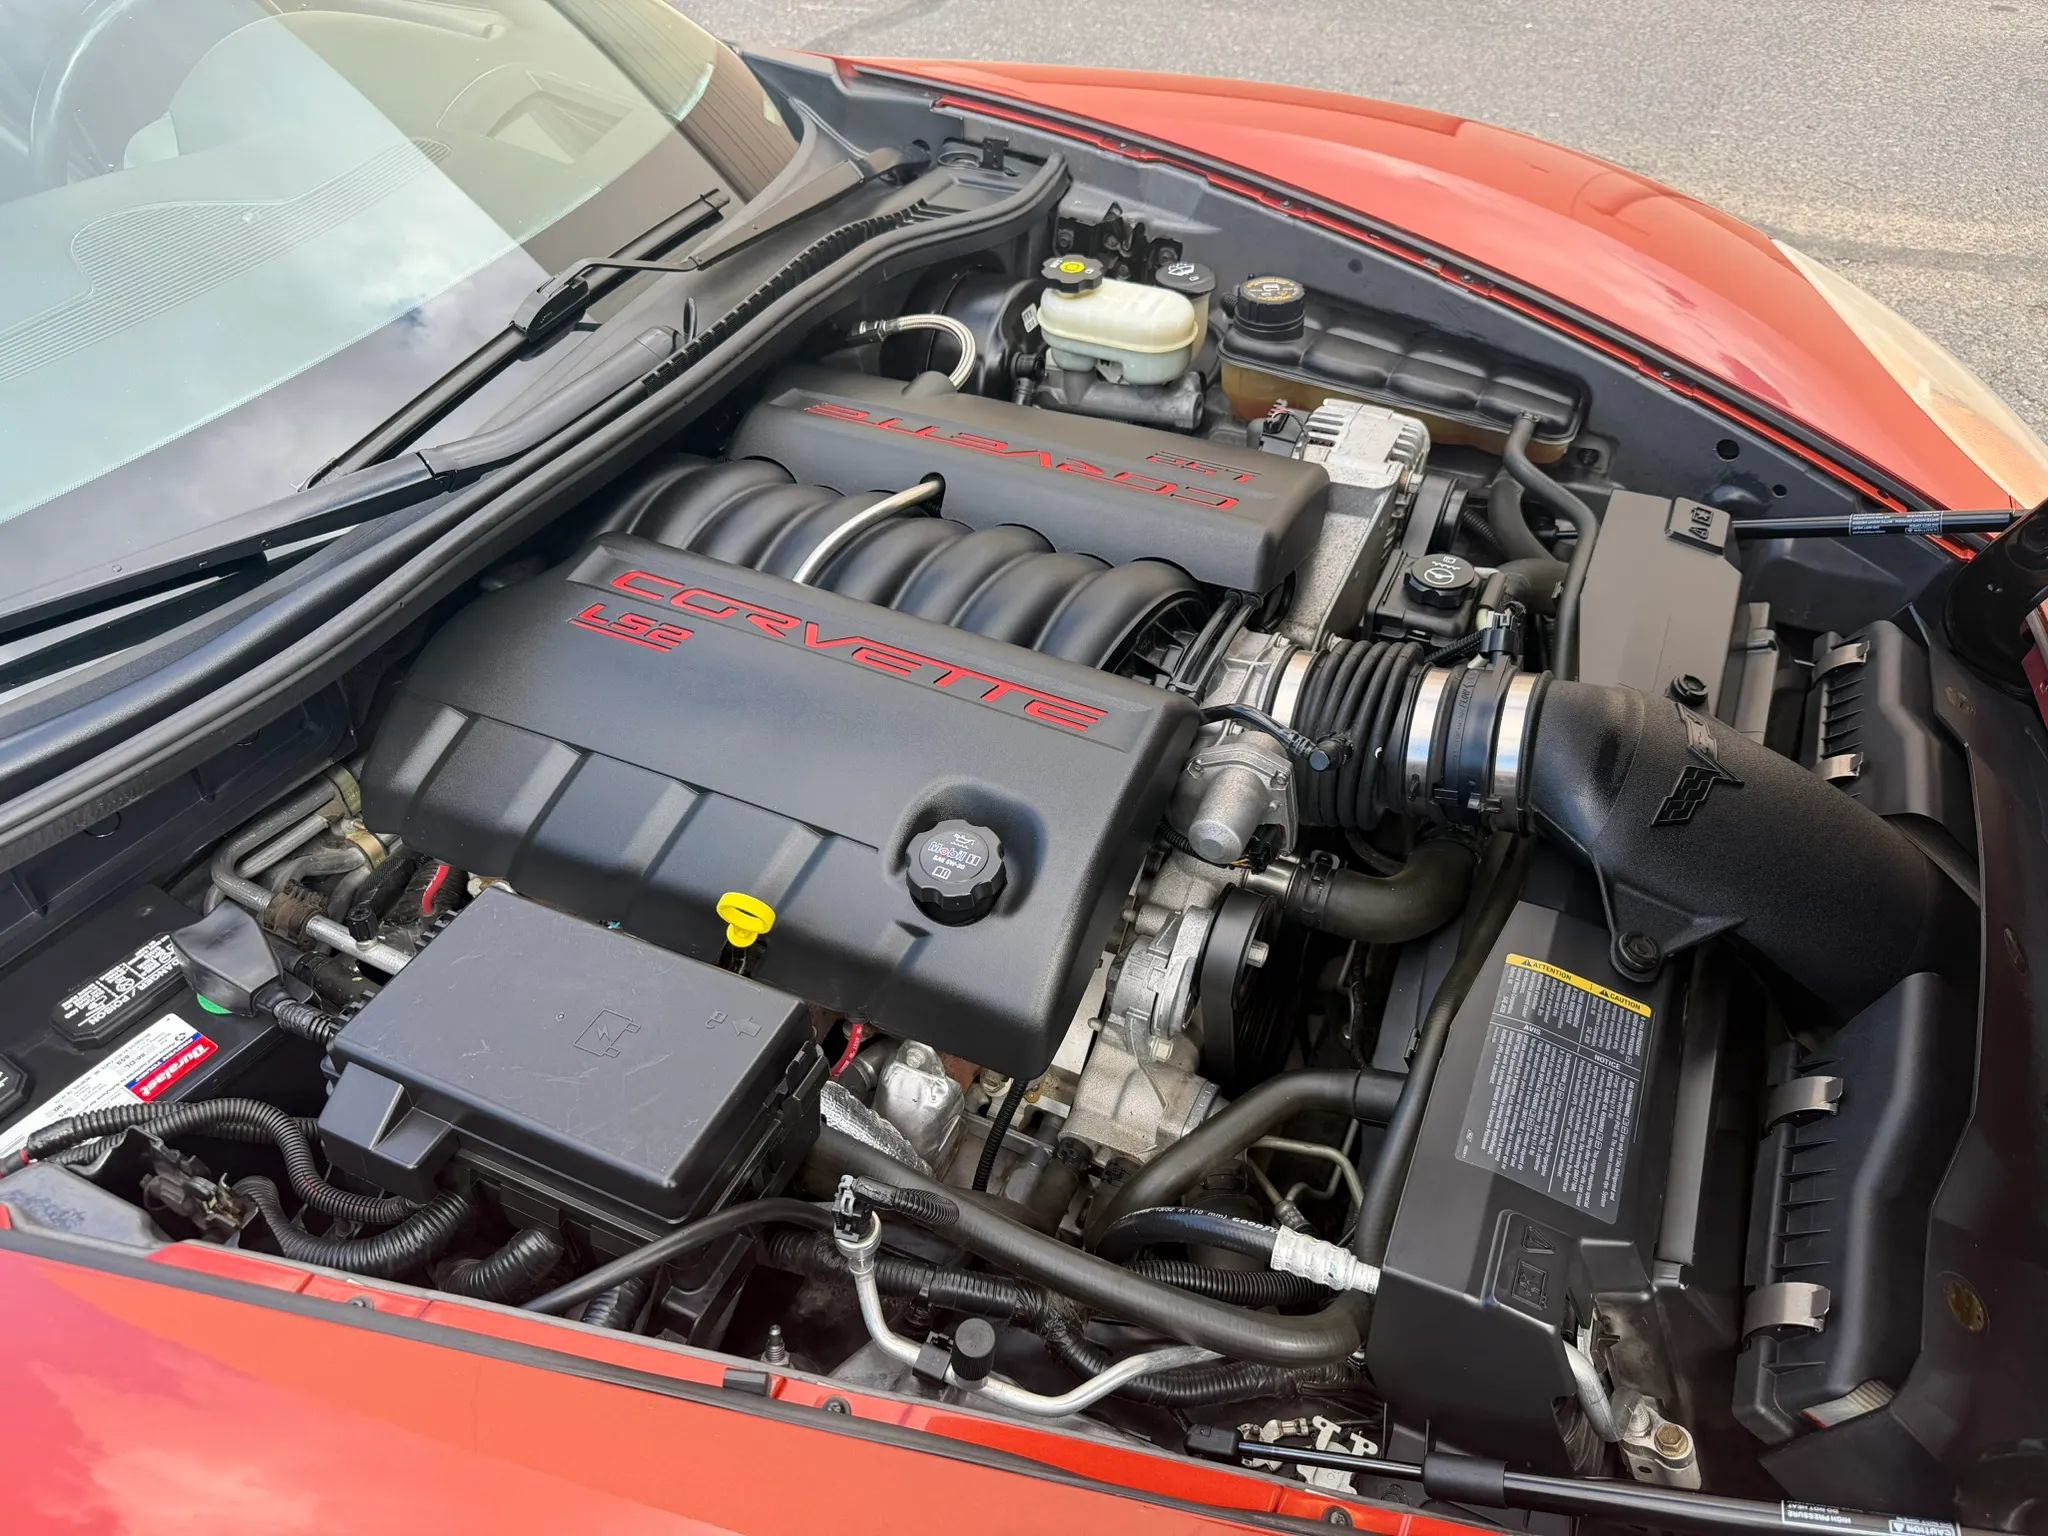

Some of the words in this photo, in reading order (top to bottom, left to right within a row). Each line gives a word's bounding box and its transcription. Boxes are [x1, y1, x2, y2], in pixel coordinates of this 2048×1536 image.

[804, 402, 1240, 510] CORVETTE
[1145, 450, 1262, 485] LS2
[573, 602, 695, 652] LS2
[609, 569, 1108, 732] CORVETTE
[928, 841, 967, 861] Mobil
[932, 855, 945, 864] SAE
[1533, 963, 1572, 981] ATTENTION
[88, 994, 129, 1026] POISON
[1610, 992, 1641, 1010] CAUTION
[1523, 1024, 1542, 1035] AVIS
[140, 1041, 209, 1098] Duralast
[1594, 1054, 1621, 1070] NOTICE
[1787, 1510, 1829, 1521] PRESSURE
[1830, 1515, 1851, 1523] HIGH
[1906, 1524, 1950, 1534] CAUTION
